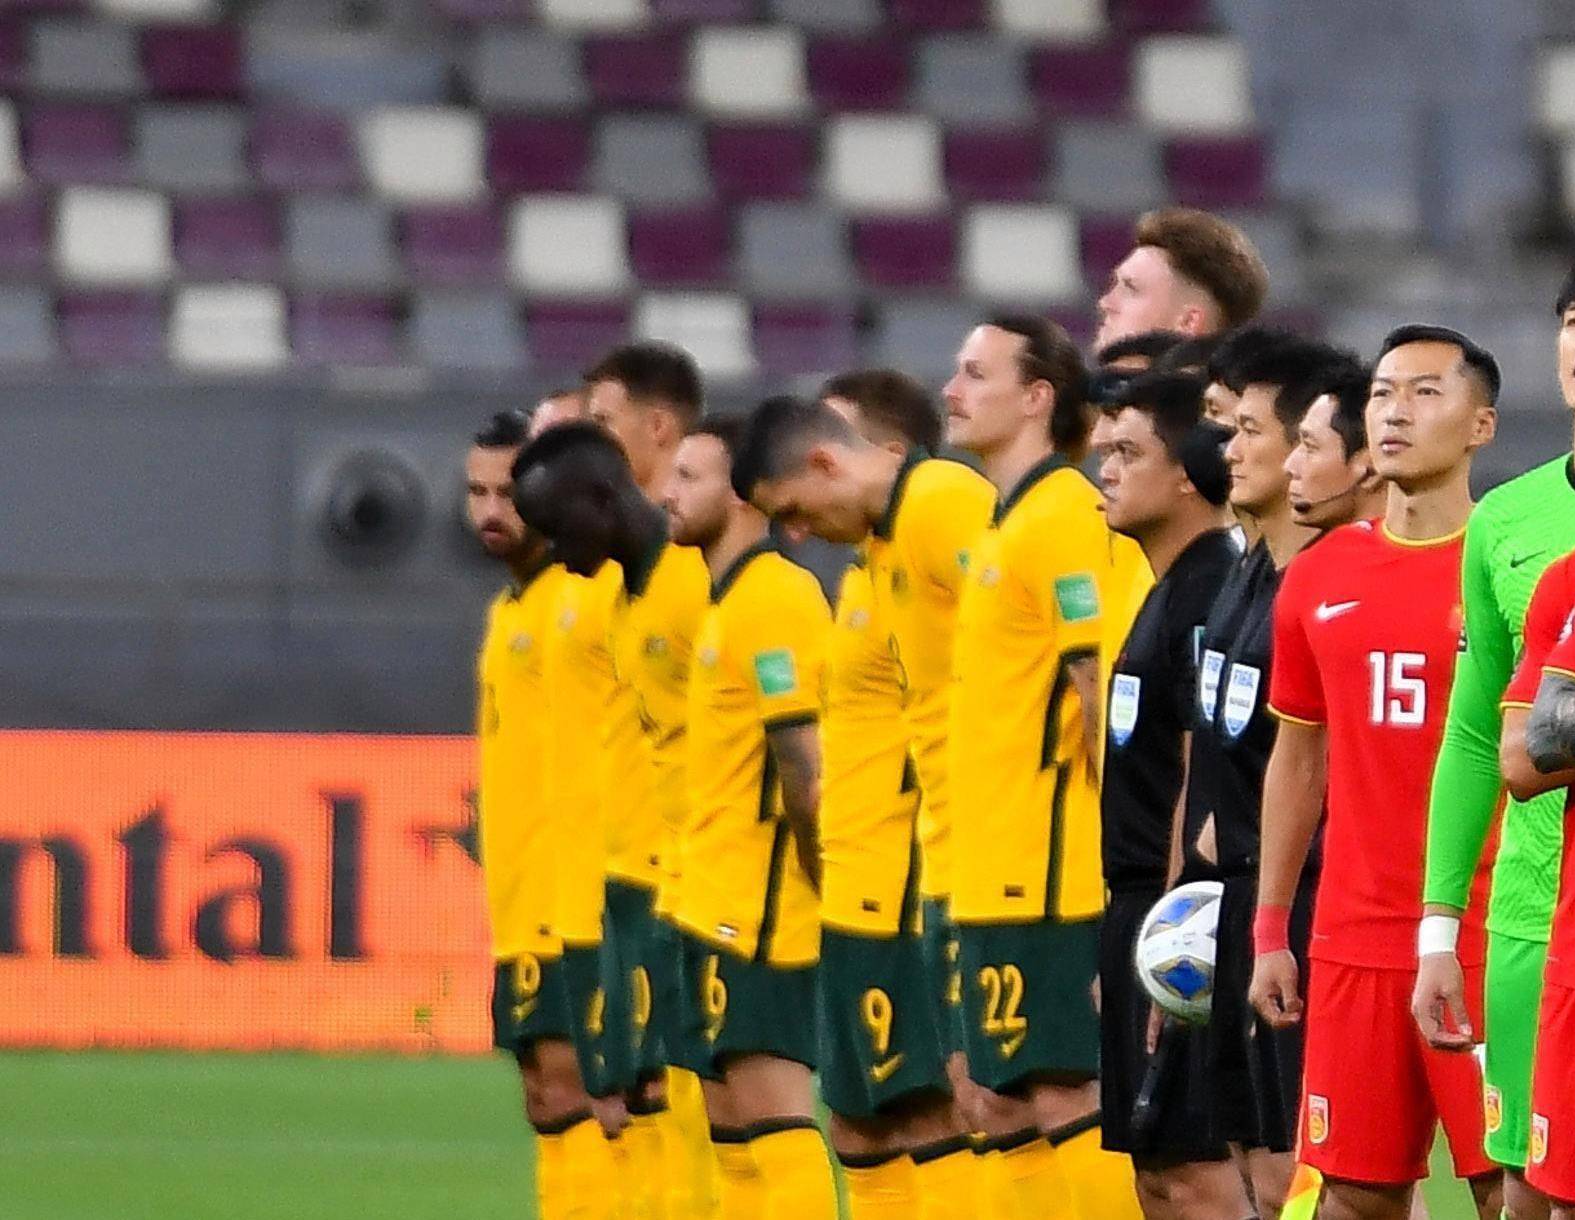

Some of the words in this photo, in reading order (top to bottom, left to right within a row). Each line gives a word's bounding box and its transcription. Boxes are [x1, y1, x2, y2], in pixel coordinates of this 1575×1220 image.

[1368, 651, 1427, 724] 15
[0, 788, 370, 964] ntal
[702, 953, 728, 1017] 6
[860, 986, 894, 1054] 9
[977, 963, 1028, 1034] 22
